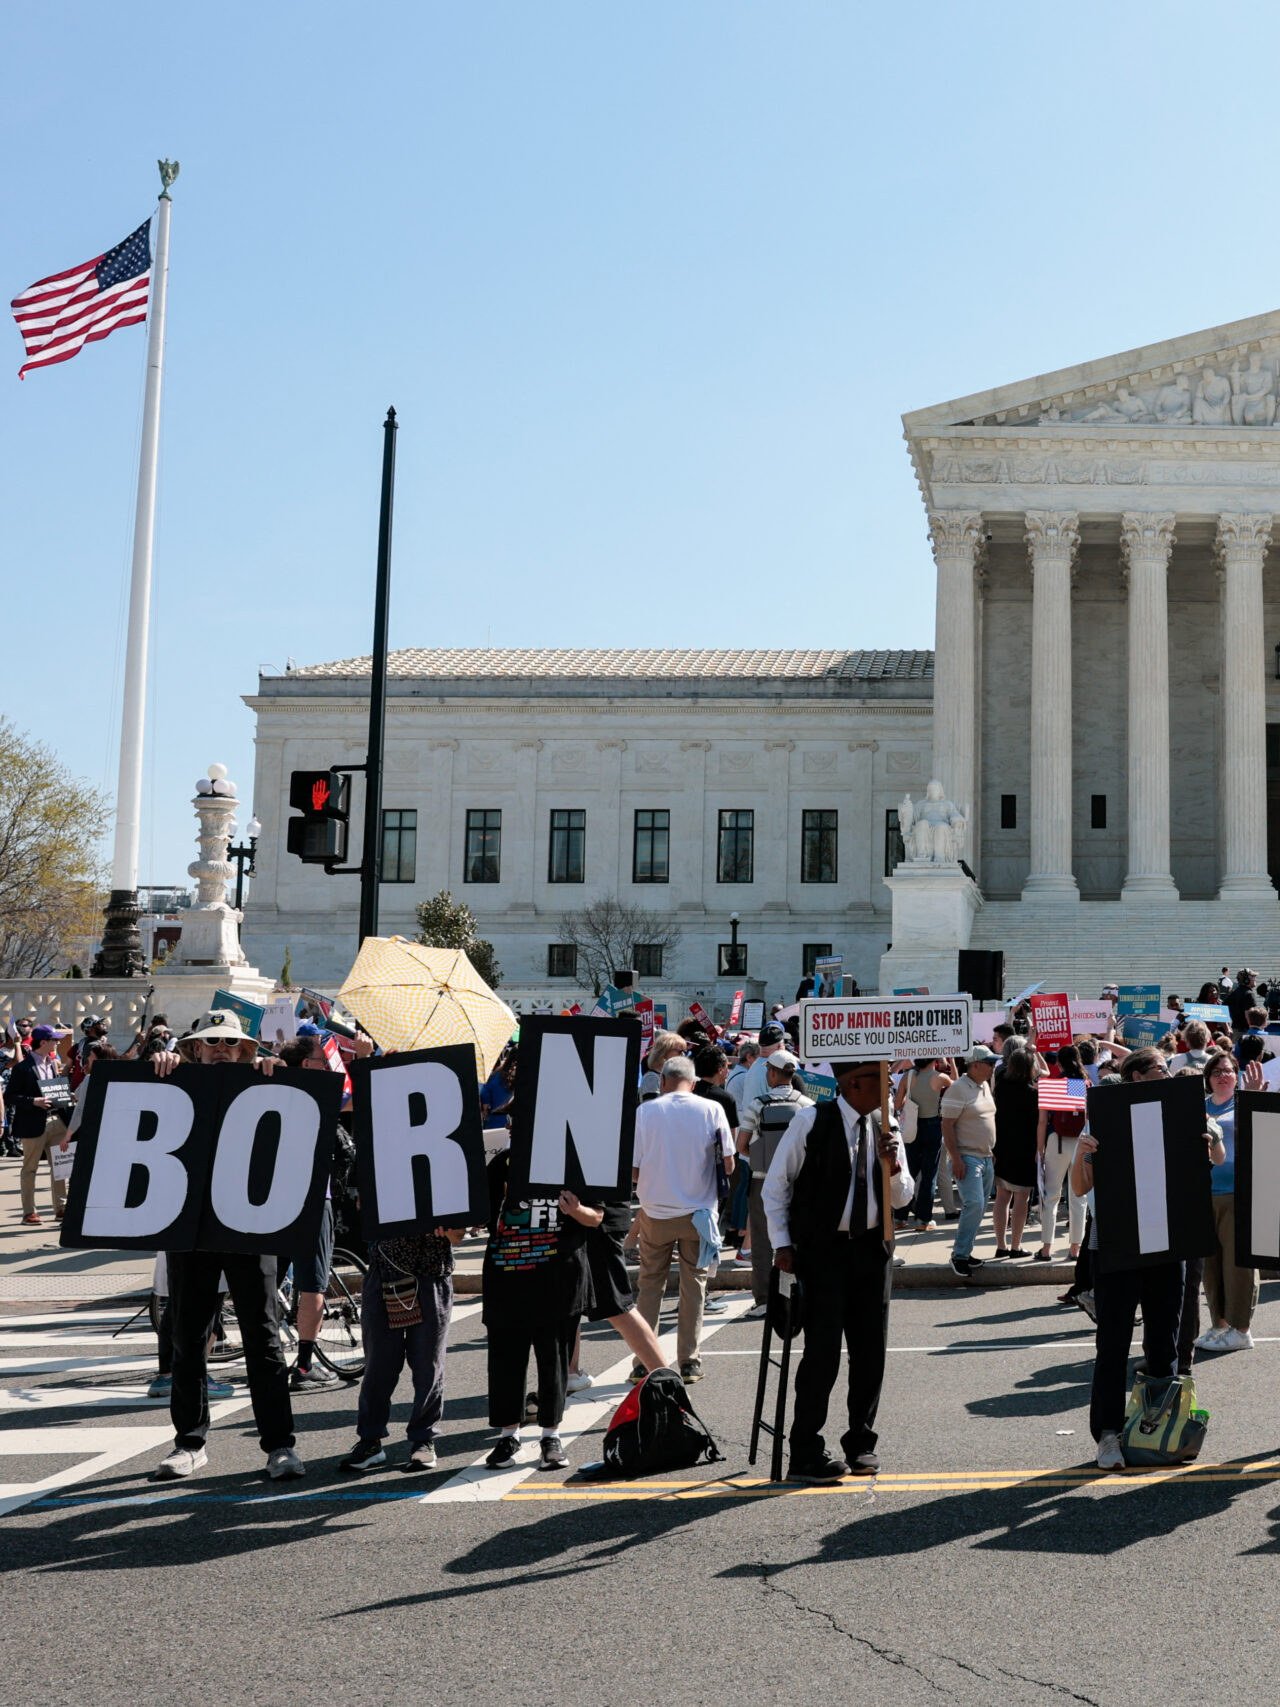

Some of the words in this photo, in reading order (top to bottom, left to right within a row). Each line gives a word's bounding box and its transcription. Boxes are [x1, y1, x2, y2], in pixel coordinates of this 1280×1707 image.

[1162, 465, 1229, 481] EQUAL
[812, 1012, 844, 1030] STOP
[848, 1011, 891, 1029] HATING
[894, 1010, 923, 1028] EACH
[927, 1009, 962, 1026] OTHER
[1034, 1006, 1066, 1020] BIRTH
[1036, 1019, 1067, 1032] RIGHT
[812, 1033, 860, 1047] BECAUSE
[864, 1032, 885, 1045] YOU
[888, 1029, 946, 1043] DISAGREE...
[893, 1048, 916, 1057] TRUTH
[917, 1046, 961, 1056] CONDUCTOR
